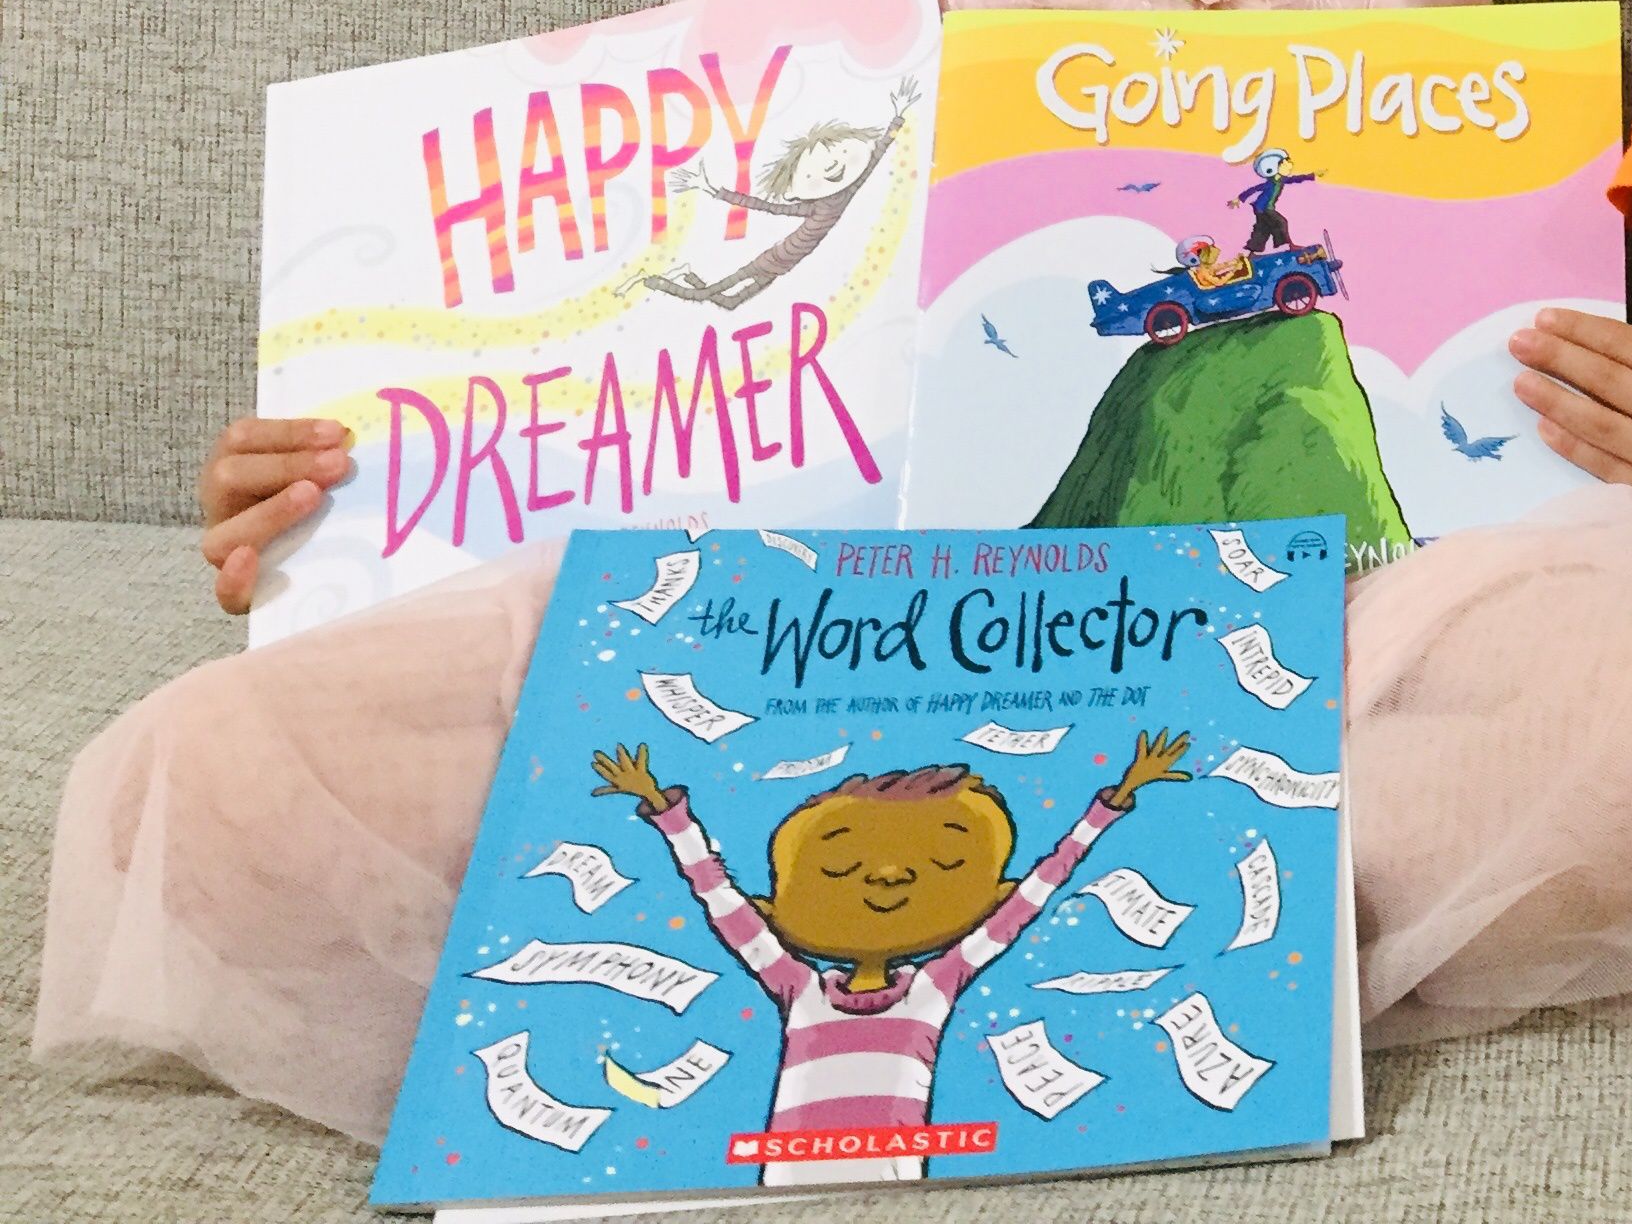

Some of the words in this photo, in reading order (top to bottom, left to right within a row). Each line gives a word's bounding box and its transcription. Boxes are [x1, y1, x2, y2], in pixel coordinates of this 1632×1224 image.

[1035, 28, 1276, 164] Going
[1287, 43, 1531, 142] Places
[422, 44, 793, 309] HAPPY
[376, 302, 883, 559] DREAMER
[635, 558, 691, 613] THANKS
[836, 541, 913, 578] PETER
[930, 542, 960, 577] H.
[974, 540, 1111, 575] REYNOLDS
[1222, 538, 1265, 583] SOAR
[688, 597, 758, 637] the
[760, 588, 930, 688] Word
[950, 574, 1208, 674] Collector
[1231, 630, 1294, 696] INTREPID
[655, 678, 726, 731] WHISPER
[765, 697, 807, 716] FROM
[846, 695, 899, 714] AUTHOR
[905, 695, 923, 713] OF
[926, 691, 978, 715] HAPPY
[981, 689, 1053, 712] DREAMER
[1058, 689, 1082, 707] AND
[1087, 687, 1118, 707] THE
[1121, 685, 1151, 707] DOT
[976, 727, 1051, 749] TETHER
[545, 850, 616, 899] DREAM
[510, 948, 699, 1003] SYMPHONY
[1000, 1030, 1085, 1108] PEACE
[1169, 1003, 1255, 1096] AZURE
[496, 1043, 590, 1140] QUANTUM
[763, 1129, 993, 1159] SCHOLASTIC
